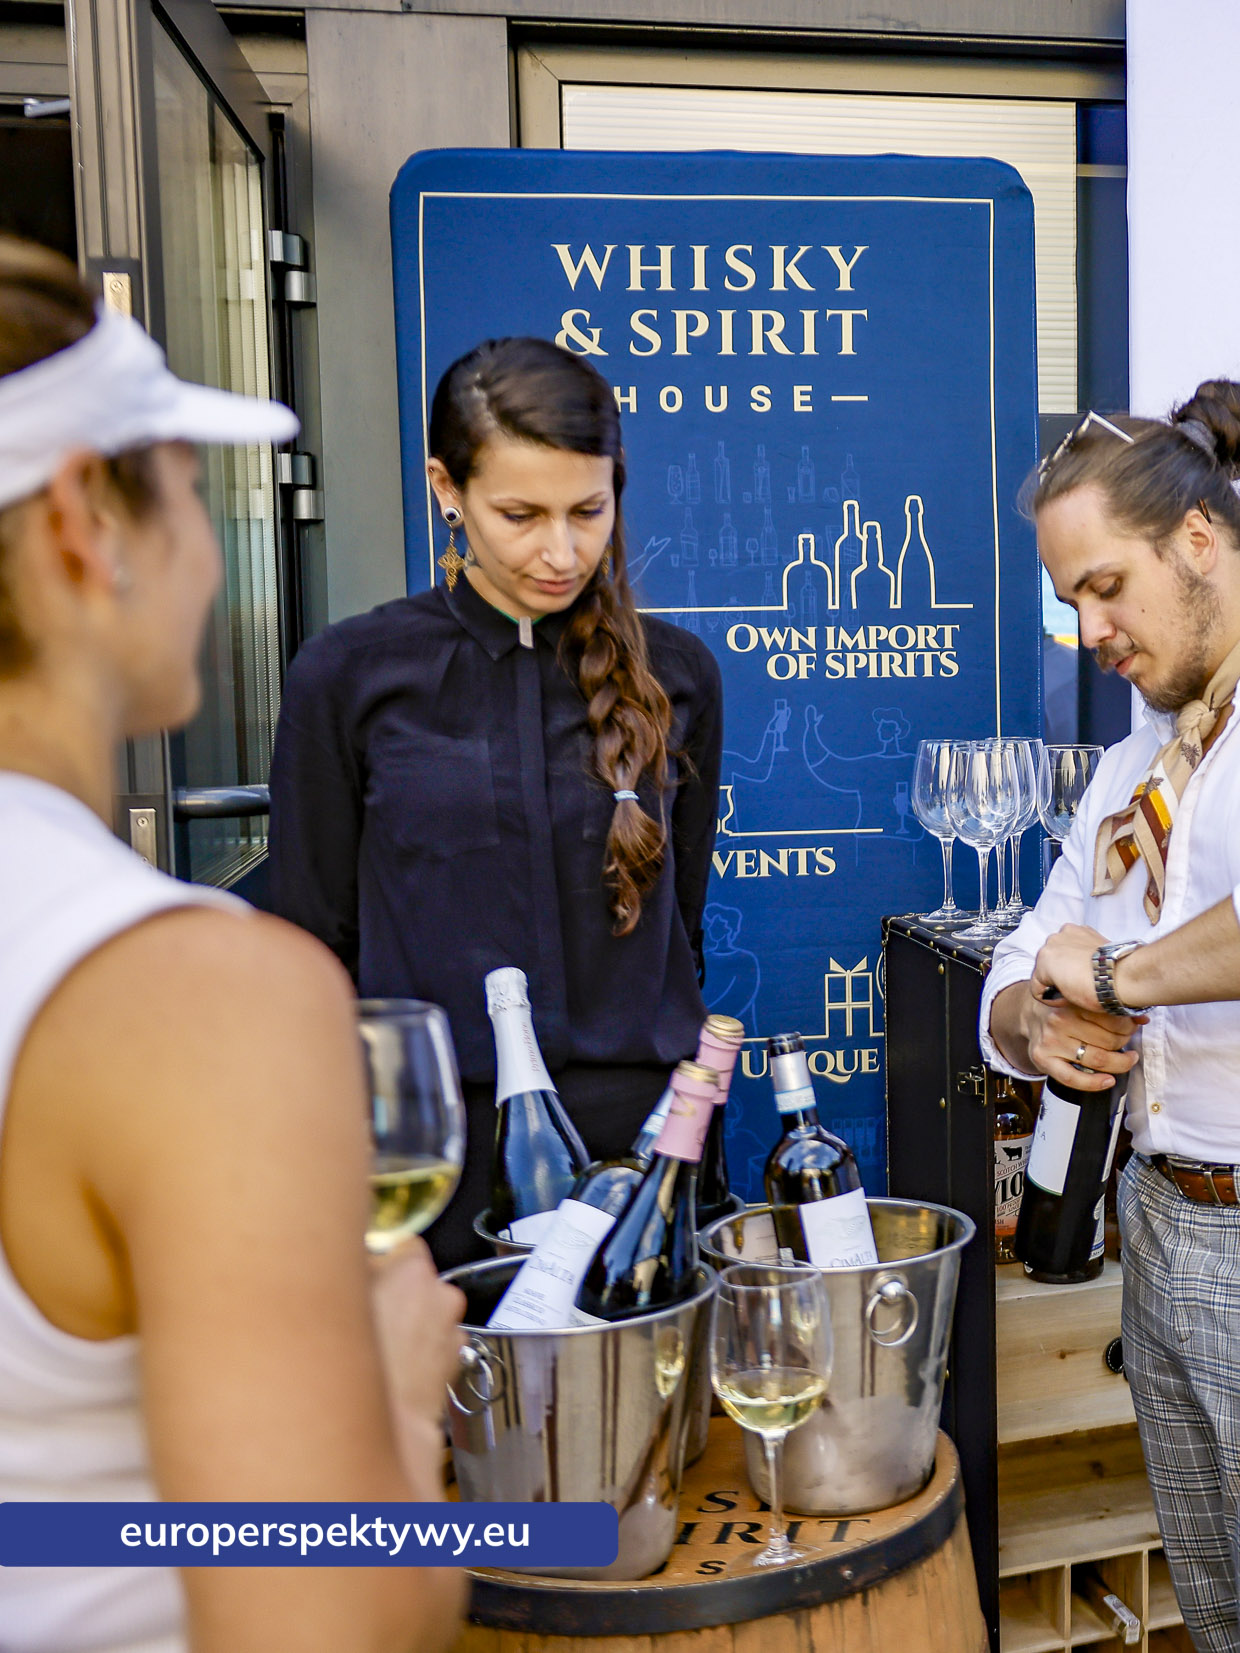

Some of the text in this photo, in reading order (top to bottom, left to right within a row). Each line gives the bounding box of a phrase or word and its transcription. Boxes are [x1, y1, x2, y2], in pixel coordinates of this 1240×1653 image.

[551, 243, 869, 292] WHISKY
[554, 308, 868, 356] & SPIRIT
[613, 385, 813, 413] HOUSE
[726, 623, 960, 651] OWN IMPORT
[766, 650, 959, 681] OF SPIRITS
[711, 846, 837, 879] VENTS
[740, 1047, 880, 1083] UQUE
[674, 1518, 871, 1545] IRIT
